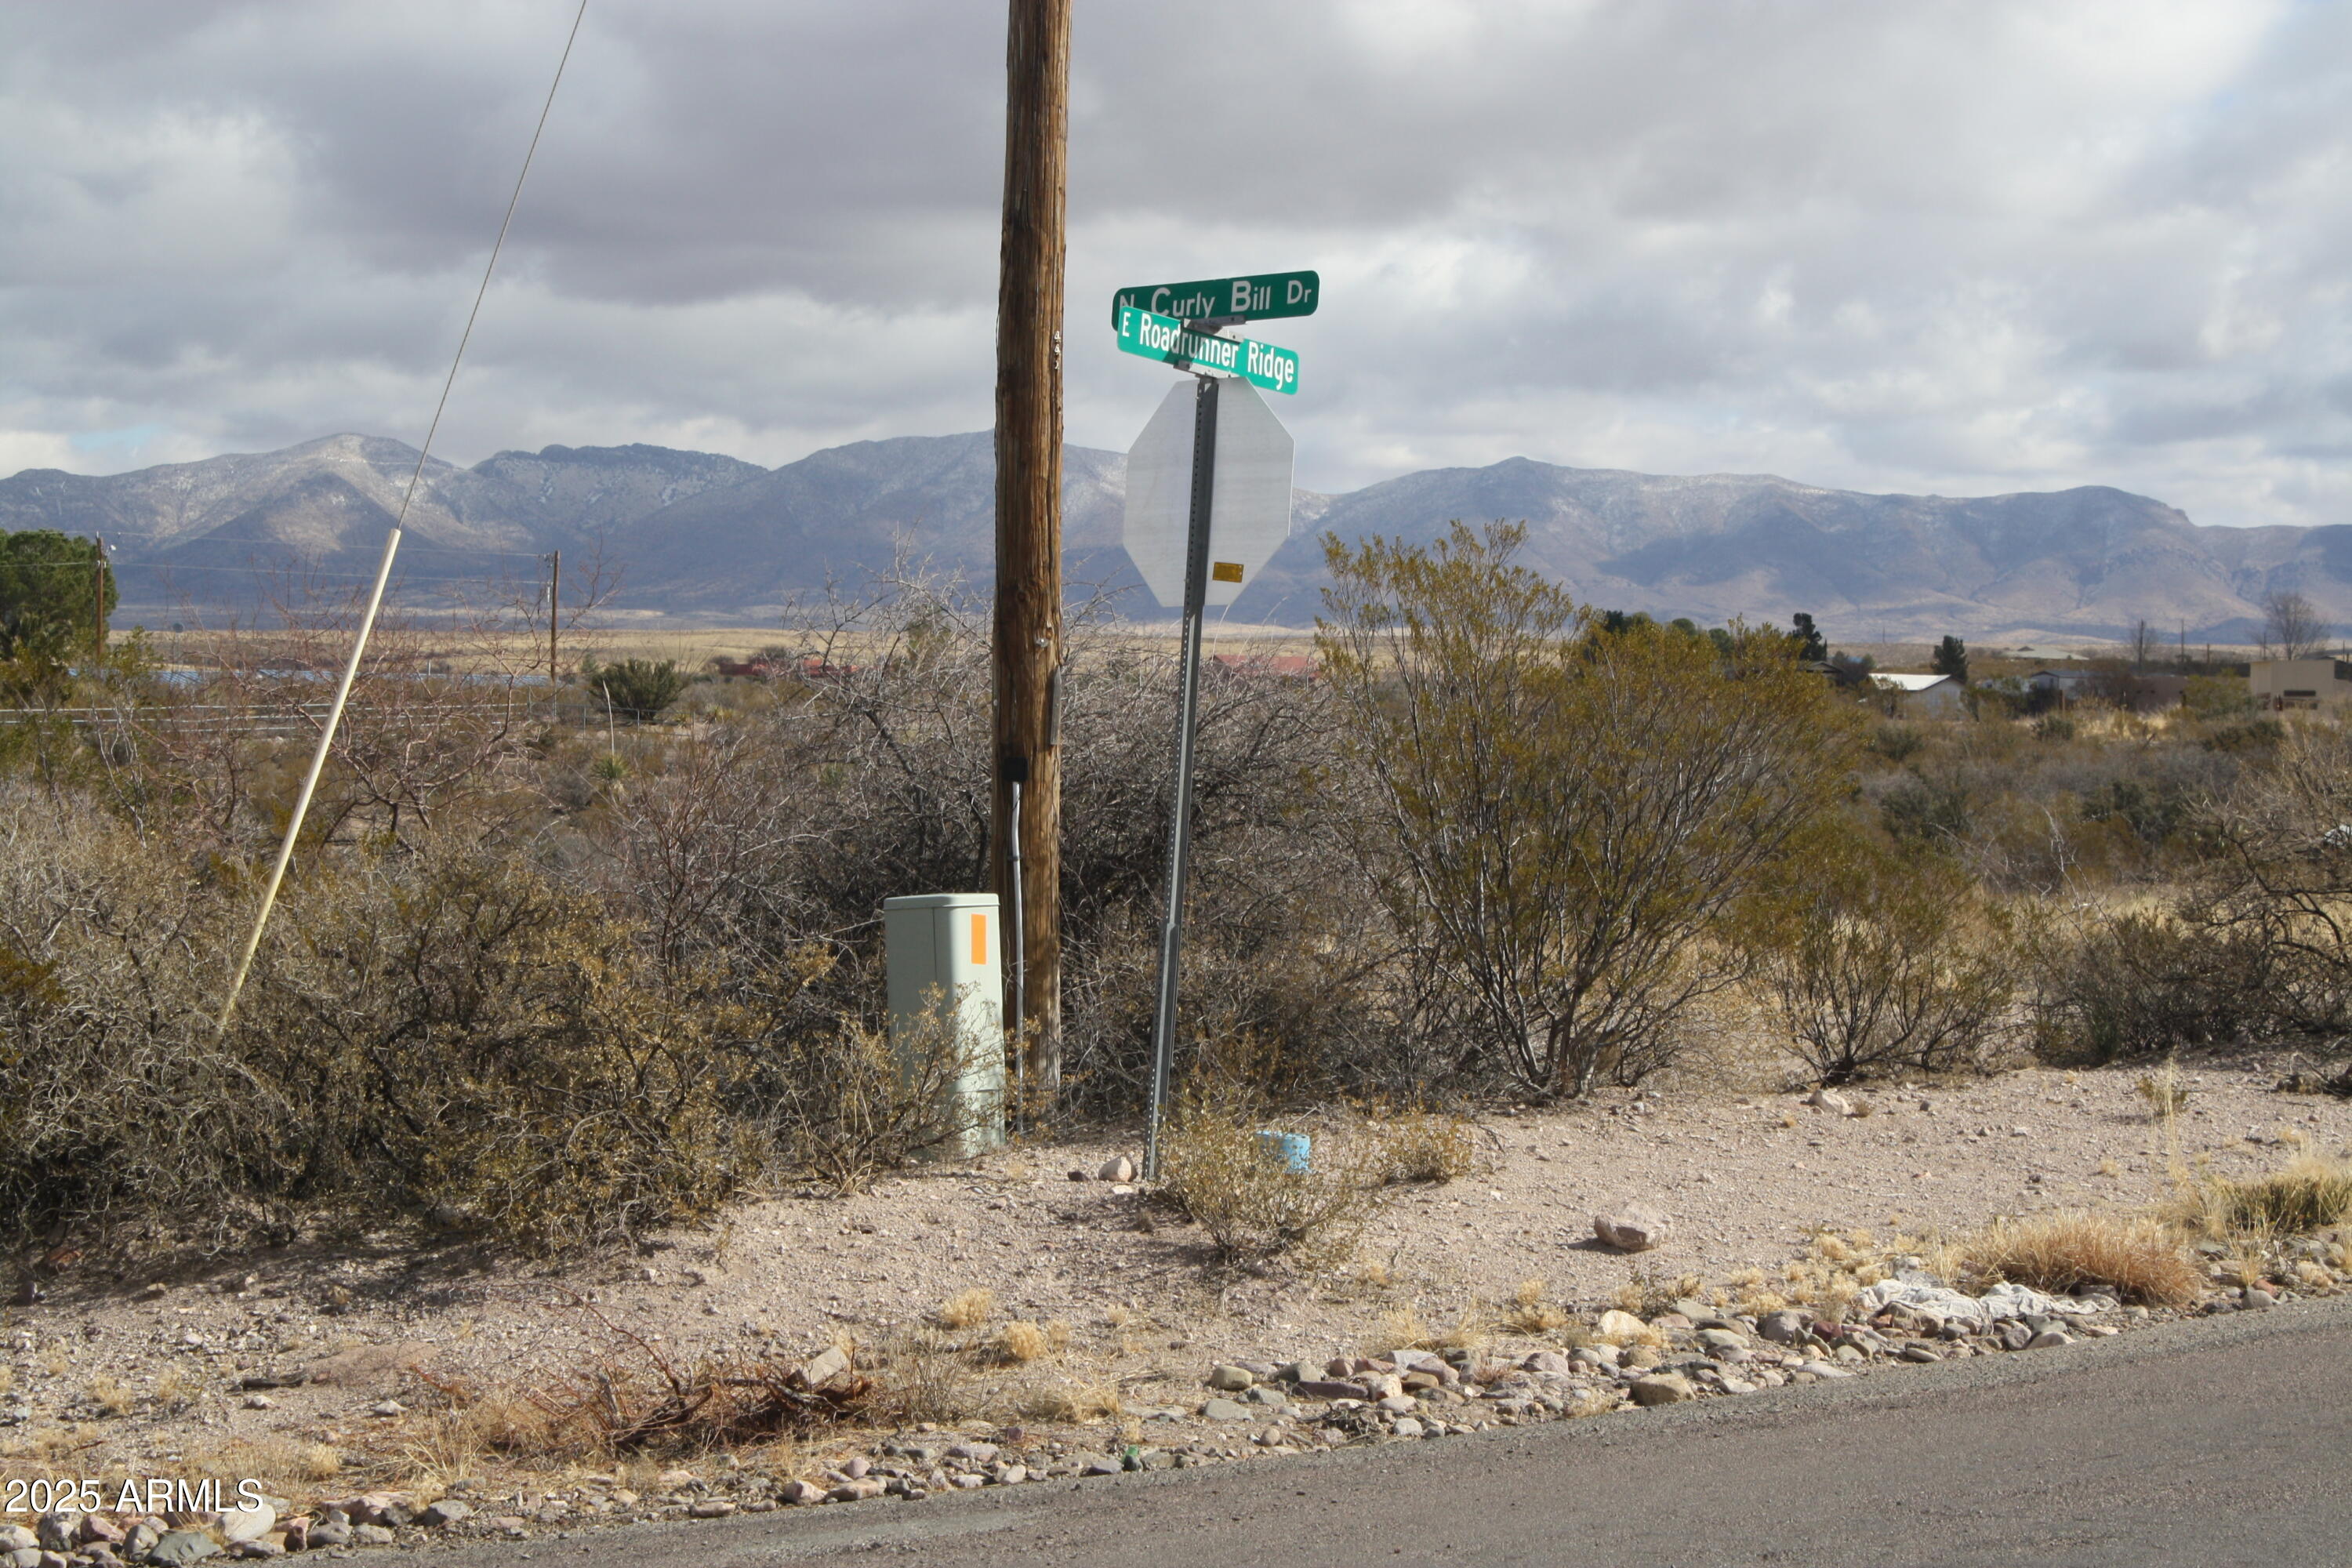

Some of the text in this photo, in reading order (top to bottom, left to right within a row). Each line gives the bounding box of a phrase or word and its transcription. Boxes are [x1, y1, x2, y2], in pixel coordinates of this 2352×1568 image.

[1151, 287, 1215, 318] Curly
[1231, 281, 1270, 312] Bill
[1287, 280, 1312, 304] Dr
[1122, 312, 1294, 390] E Roadrunner Ridge
